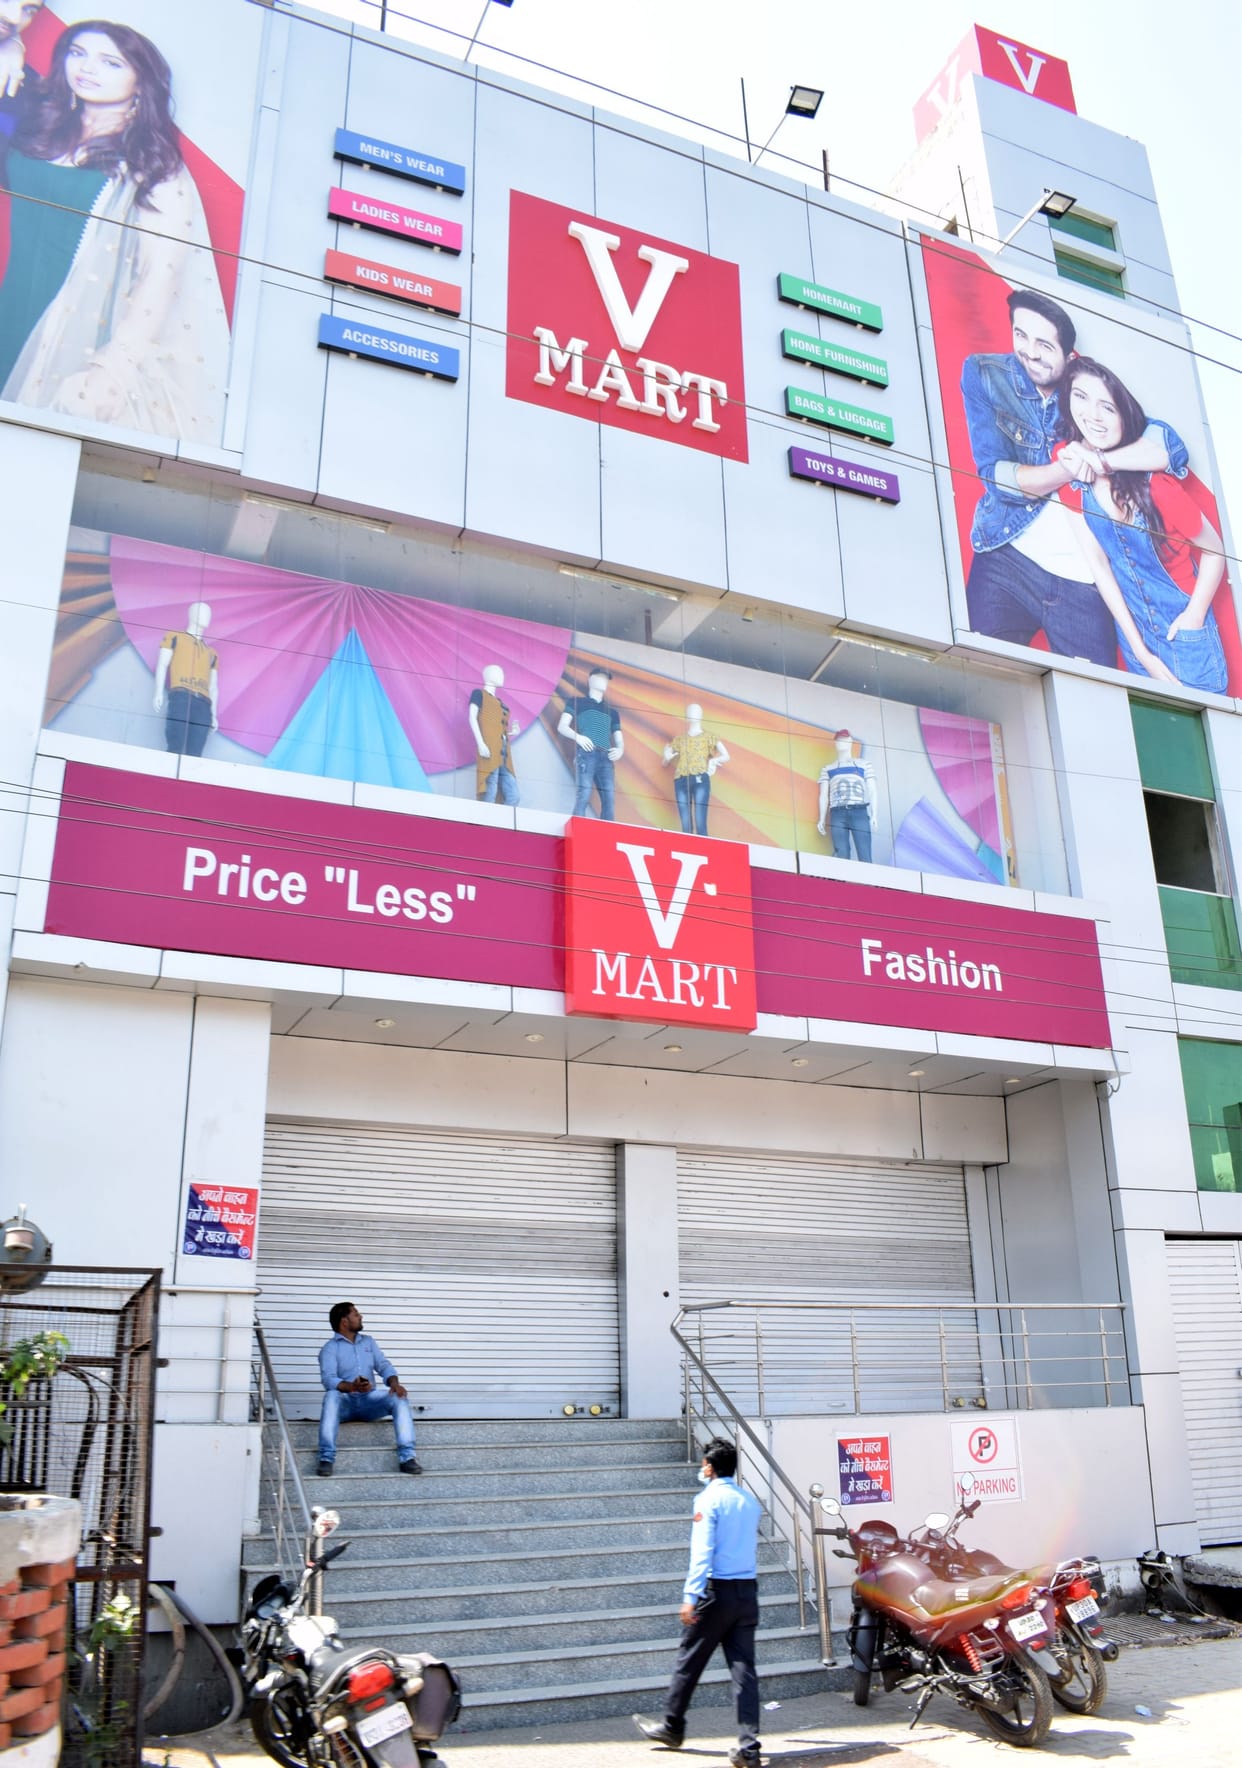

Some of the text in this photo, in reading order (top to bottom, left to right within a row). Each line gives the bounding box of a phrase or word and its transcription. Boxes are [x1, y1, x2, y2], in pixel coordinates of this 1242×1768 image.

[997, 39, 1046, 94] V
[359, 141, 444, 177] MEN'S WEAR
[352, 200, 443, 237] LADIES WEAR
[355, 264, 433, 297] KIDS WEAR
[568, 220, 689, 353] V
[802, 286, 863, 316] HOMEMART
[342, 328, 440, 364] ACCESSORIES
[790, 336, 887, 377] HOME FURNISHING
[533, 326, 728, 433] MART
[794, 395, 887, 433] BAGS & LUGGAGE
[805, 457, 888, 490] TOYS & GAMES
[183, 846, 477, 924] Price "Less"
[616, 842, 708, 950] V
[591, 948, 737, 1010] MART
[861, 938, 1003, 992] Fashion
[187, 1205, 202, 1220] को
[978, 1436, 991, 1456] P
[840, 1458, 850, 1473] को
[973, 1478, 1016, 1496] PARKING
